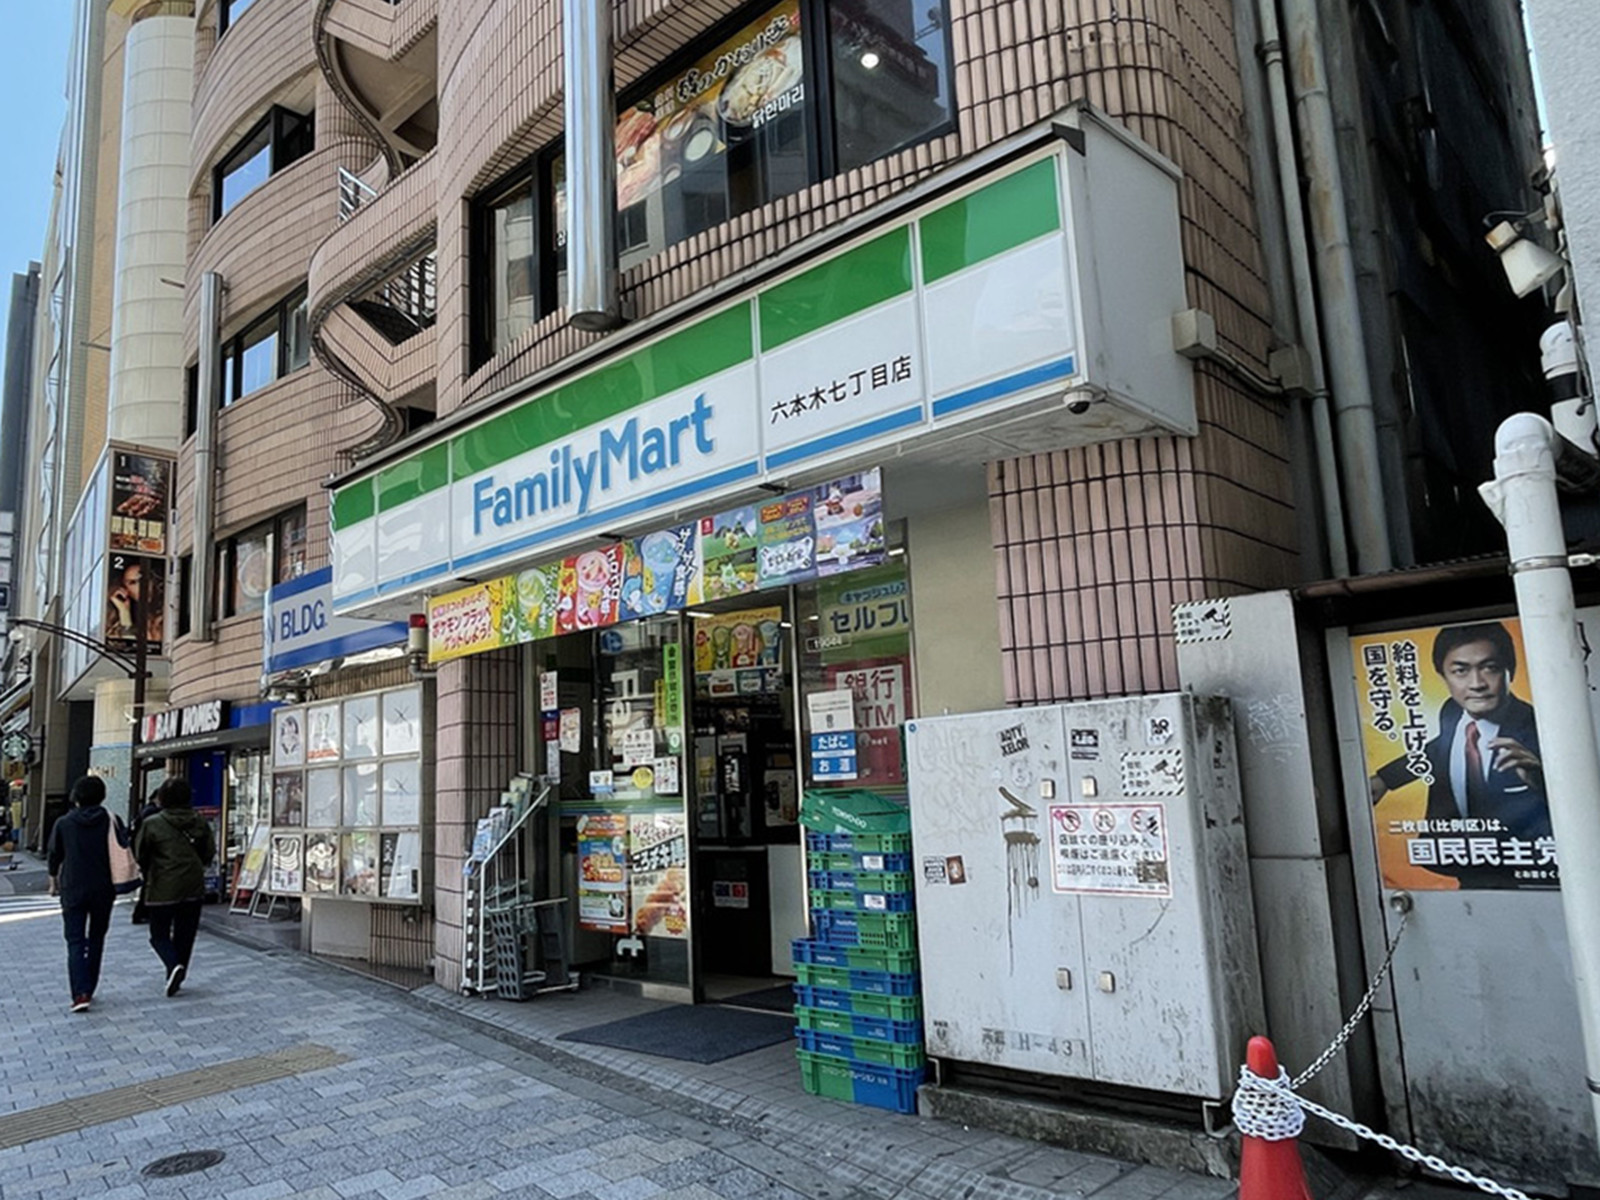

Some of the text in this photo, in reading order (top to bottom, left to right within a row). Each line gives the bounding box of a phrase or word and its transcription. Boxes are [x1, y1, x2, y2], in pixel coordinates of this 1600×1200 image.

[752, 83, 805, 129] 닭한마리
[771, 355, 911, 425] 六本木七丁目店
[121, 455, 126, 468] 1
[473, 393, 714, 536] FamilyMart
[113, 556, 125, 570] 2
[845, 668, 896, 702] 銀行
[1363, 644, 1398, 741] 国を守る。
[181, 699, 222, 737] HOMES
[857, 703, 896, 728] TM
[1391, 641, 1434, 785] 給料を上げる。
[818, 735, 849, 750] たばこ
[1406, 836, 1558, 866] 国民民主党
